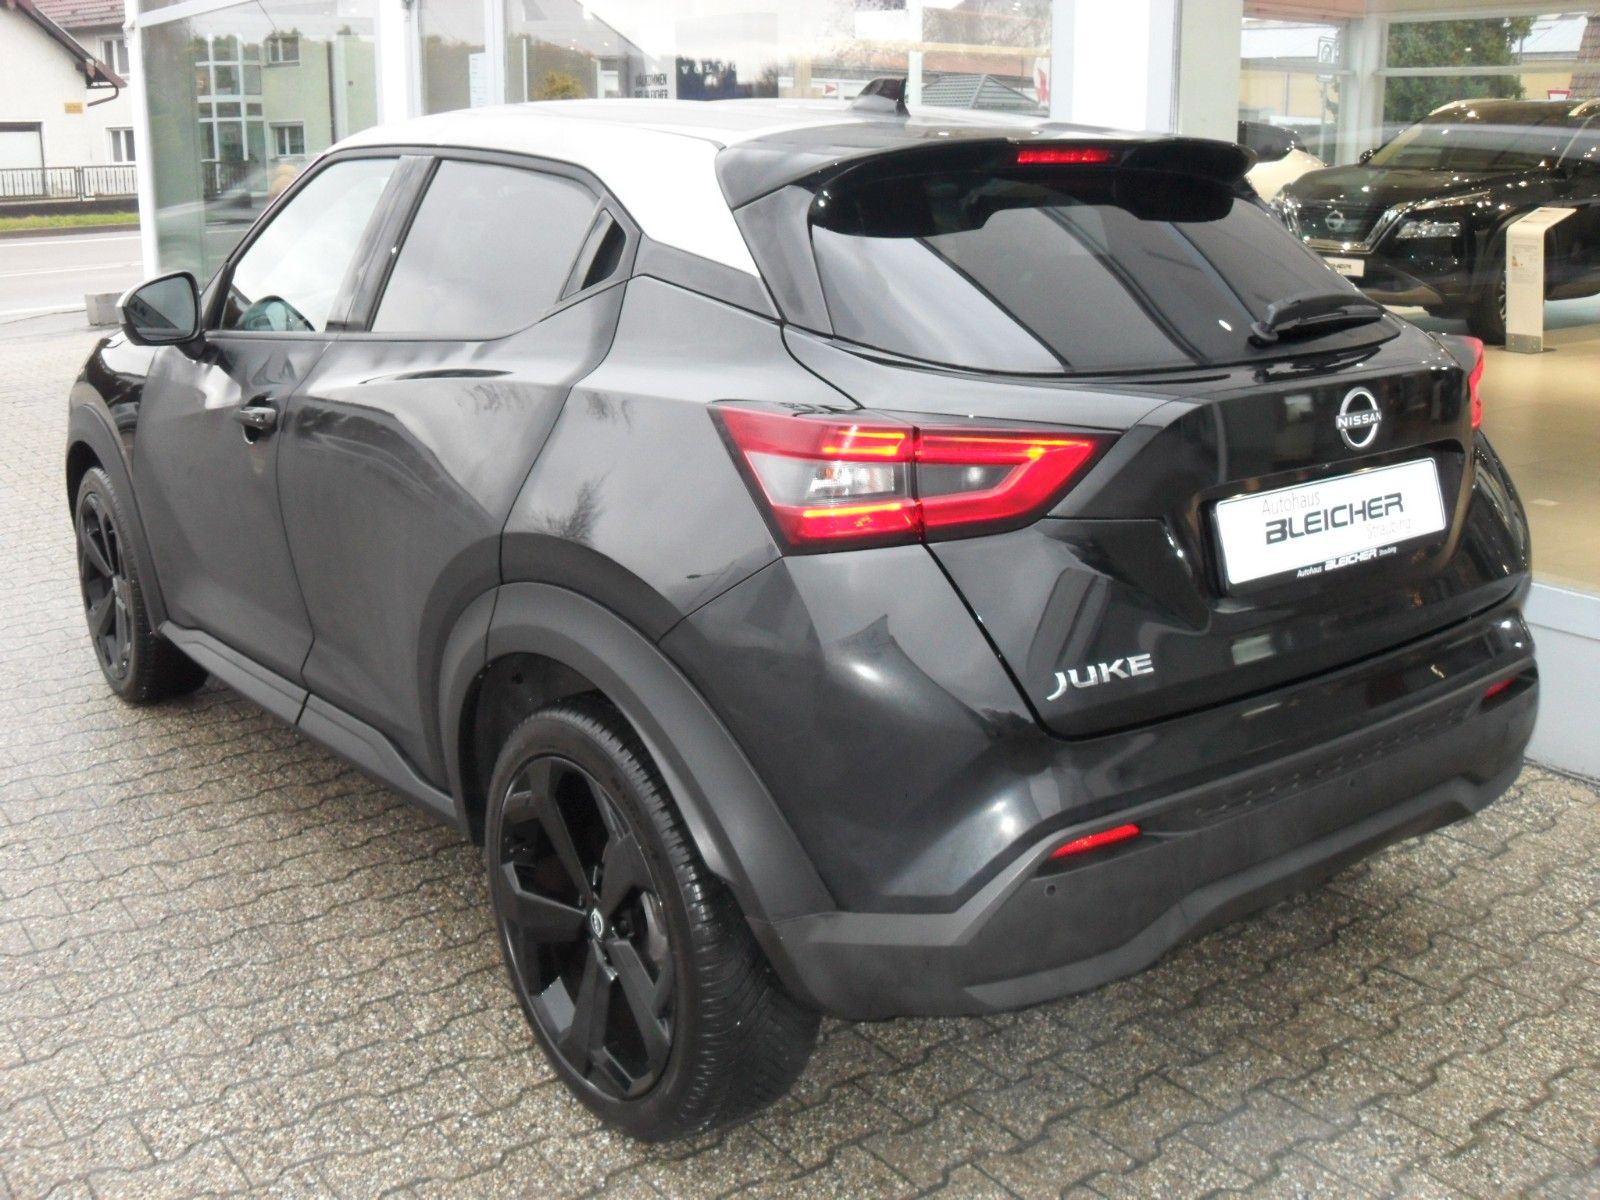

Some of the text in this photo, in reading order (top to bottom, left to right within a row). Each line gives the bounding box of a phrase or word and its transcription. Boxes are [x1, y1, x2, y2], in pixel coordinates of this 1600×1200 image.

[1337, 411, 1382, 428] NISSAN
[1262, 490, 1321, 515] Autohaus
[1265, 492, 1404, 545] BLEICHER
[1324, 548, 1377, 571] BLEICHER
[1046, 653, 1155, 701] JUKE
